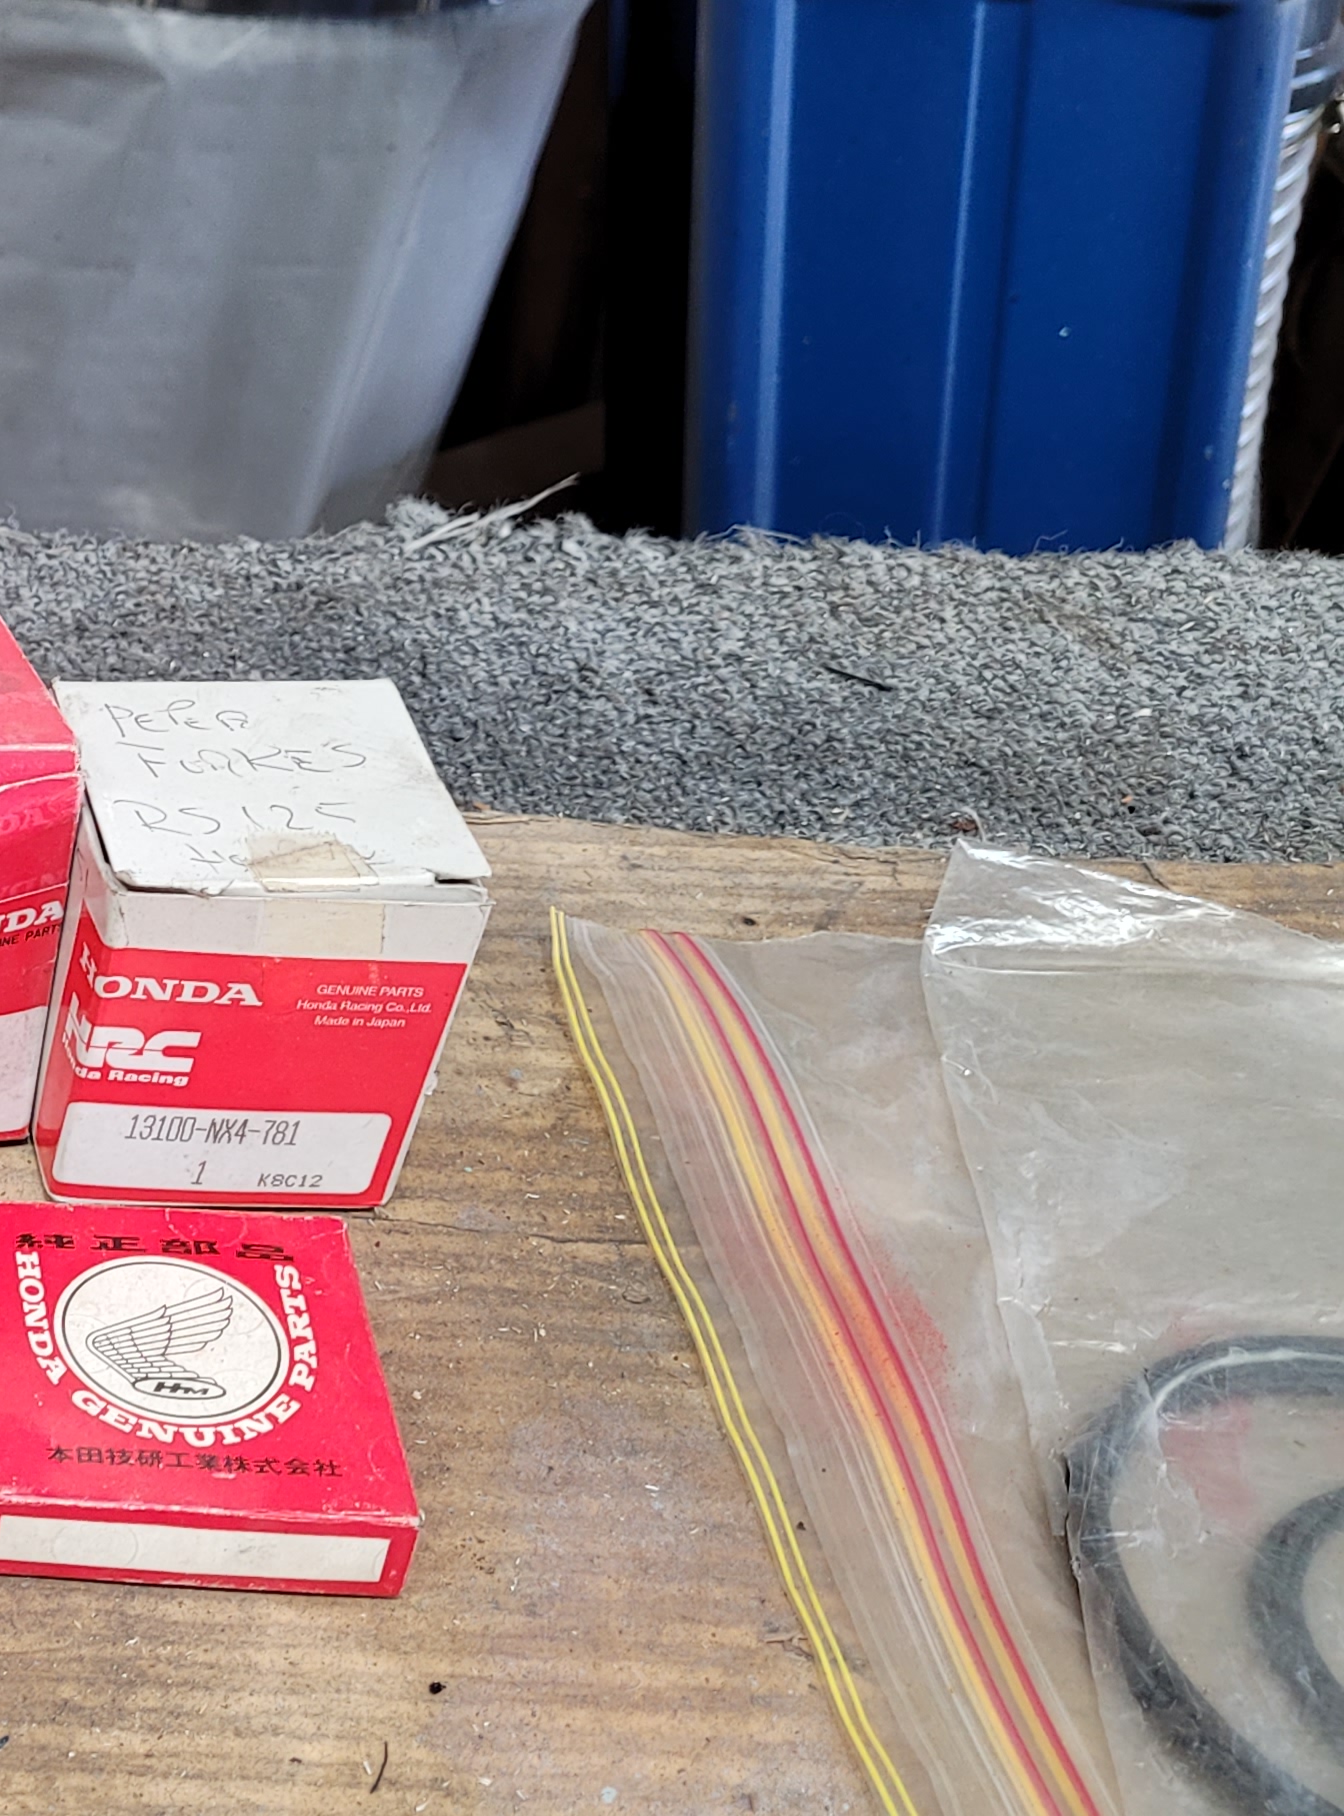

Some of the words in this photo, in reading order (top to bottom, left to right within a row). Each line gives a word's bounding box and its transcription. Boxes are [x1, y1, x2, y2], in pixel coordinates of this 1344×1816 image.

[79, 941, 263, 1007] HONDA
[316, 984, 377, 997] GENUINE
[378, 986, 425, 998] PARTS
[296, 1000, 337, 1012] Honda
[340, 1001, 383, 1015] Racing
[314, 1014, 349, 1027] Made
[353, 1015, 364, 1027] in
[366, 1016, 406, 1029] Japan
[108, 1069, 189, 1087] Racing
[124, 1113, 301, 1146] 13100-NX4-781
[191, 1160, 207, 1185] 1
[16, 1251, 68, 1385] HONDA
[71, 1389, 301, 1448] GENUINE
[274, 1263, 318, 1392] PARTS
[46, 1447, 344, 1479] 本田技研工業株式会社
